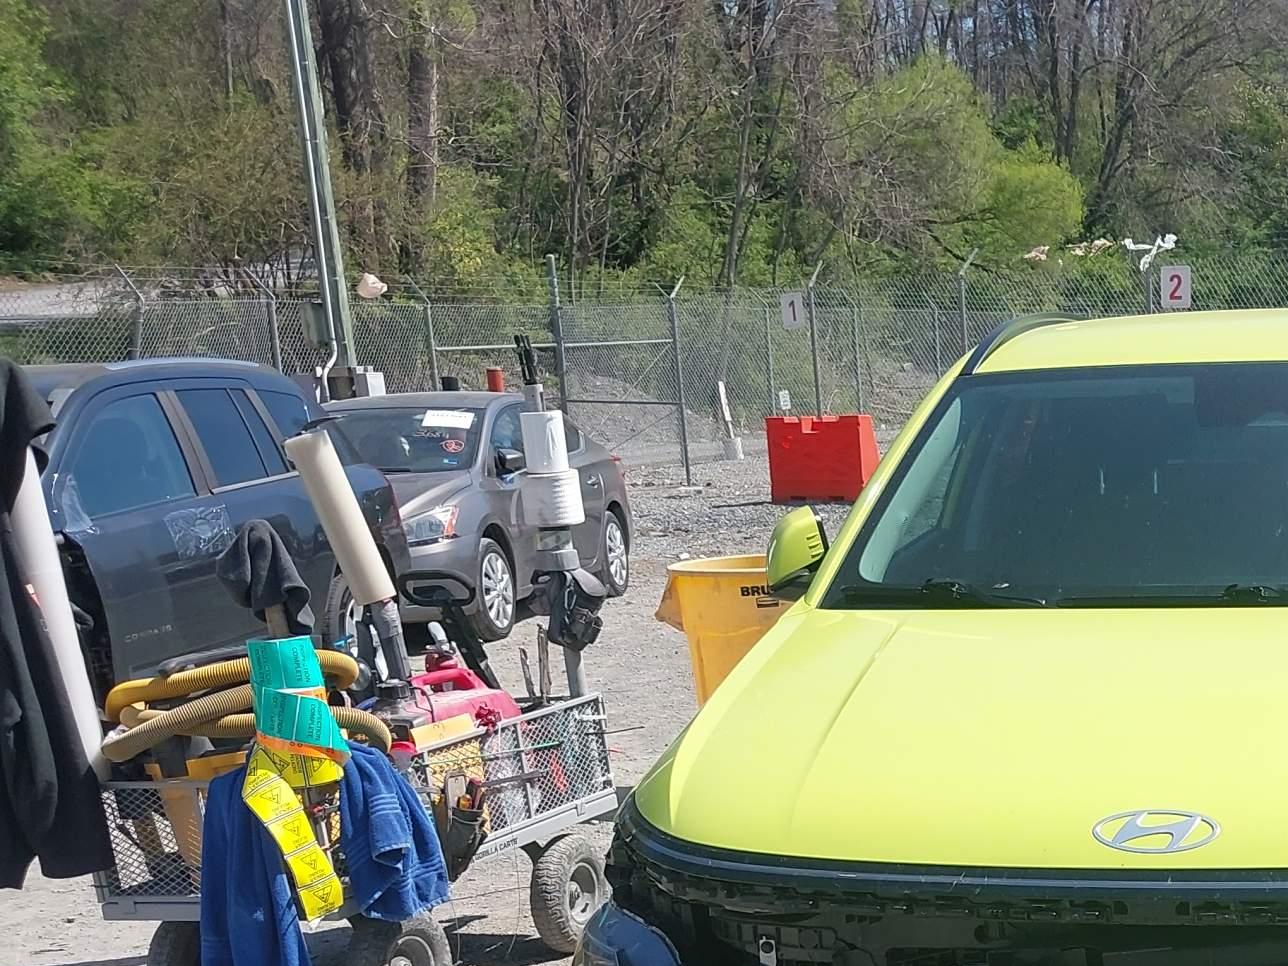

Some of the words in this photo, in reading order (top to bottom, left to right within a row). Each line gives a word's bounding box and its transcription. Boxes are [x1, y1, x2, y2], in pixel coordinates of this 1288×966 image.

[1167, 273, 1183, 300] 2
[787, 299, 799, 321] 1
[740, 585, 769, 596] BRU
